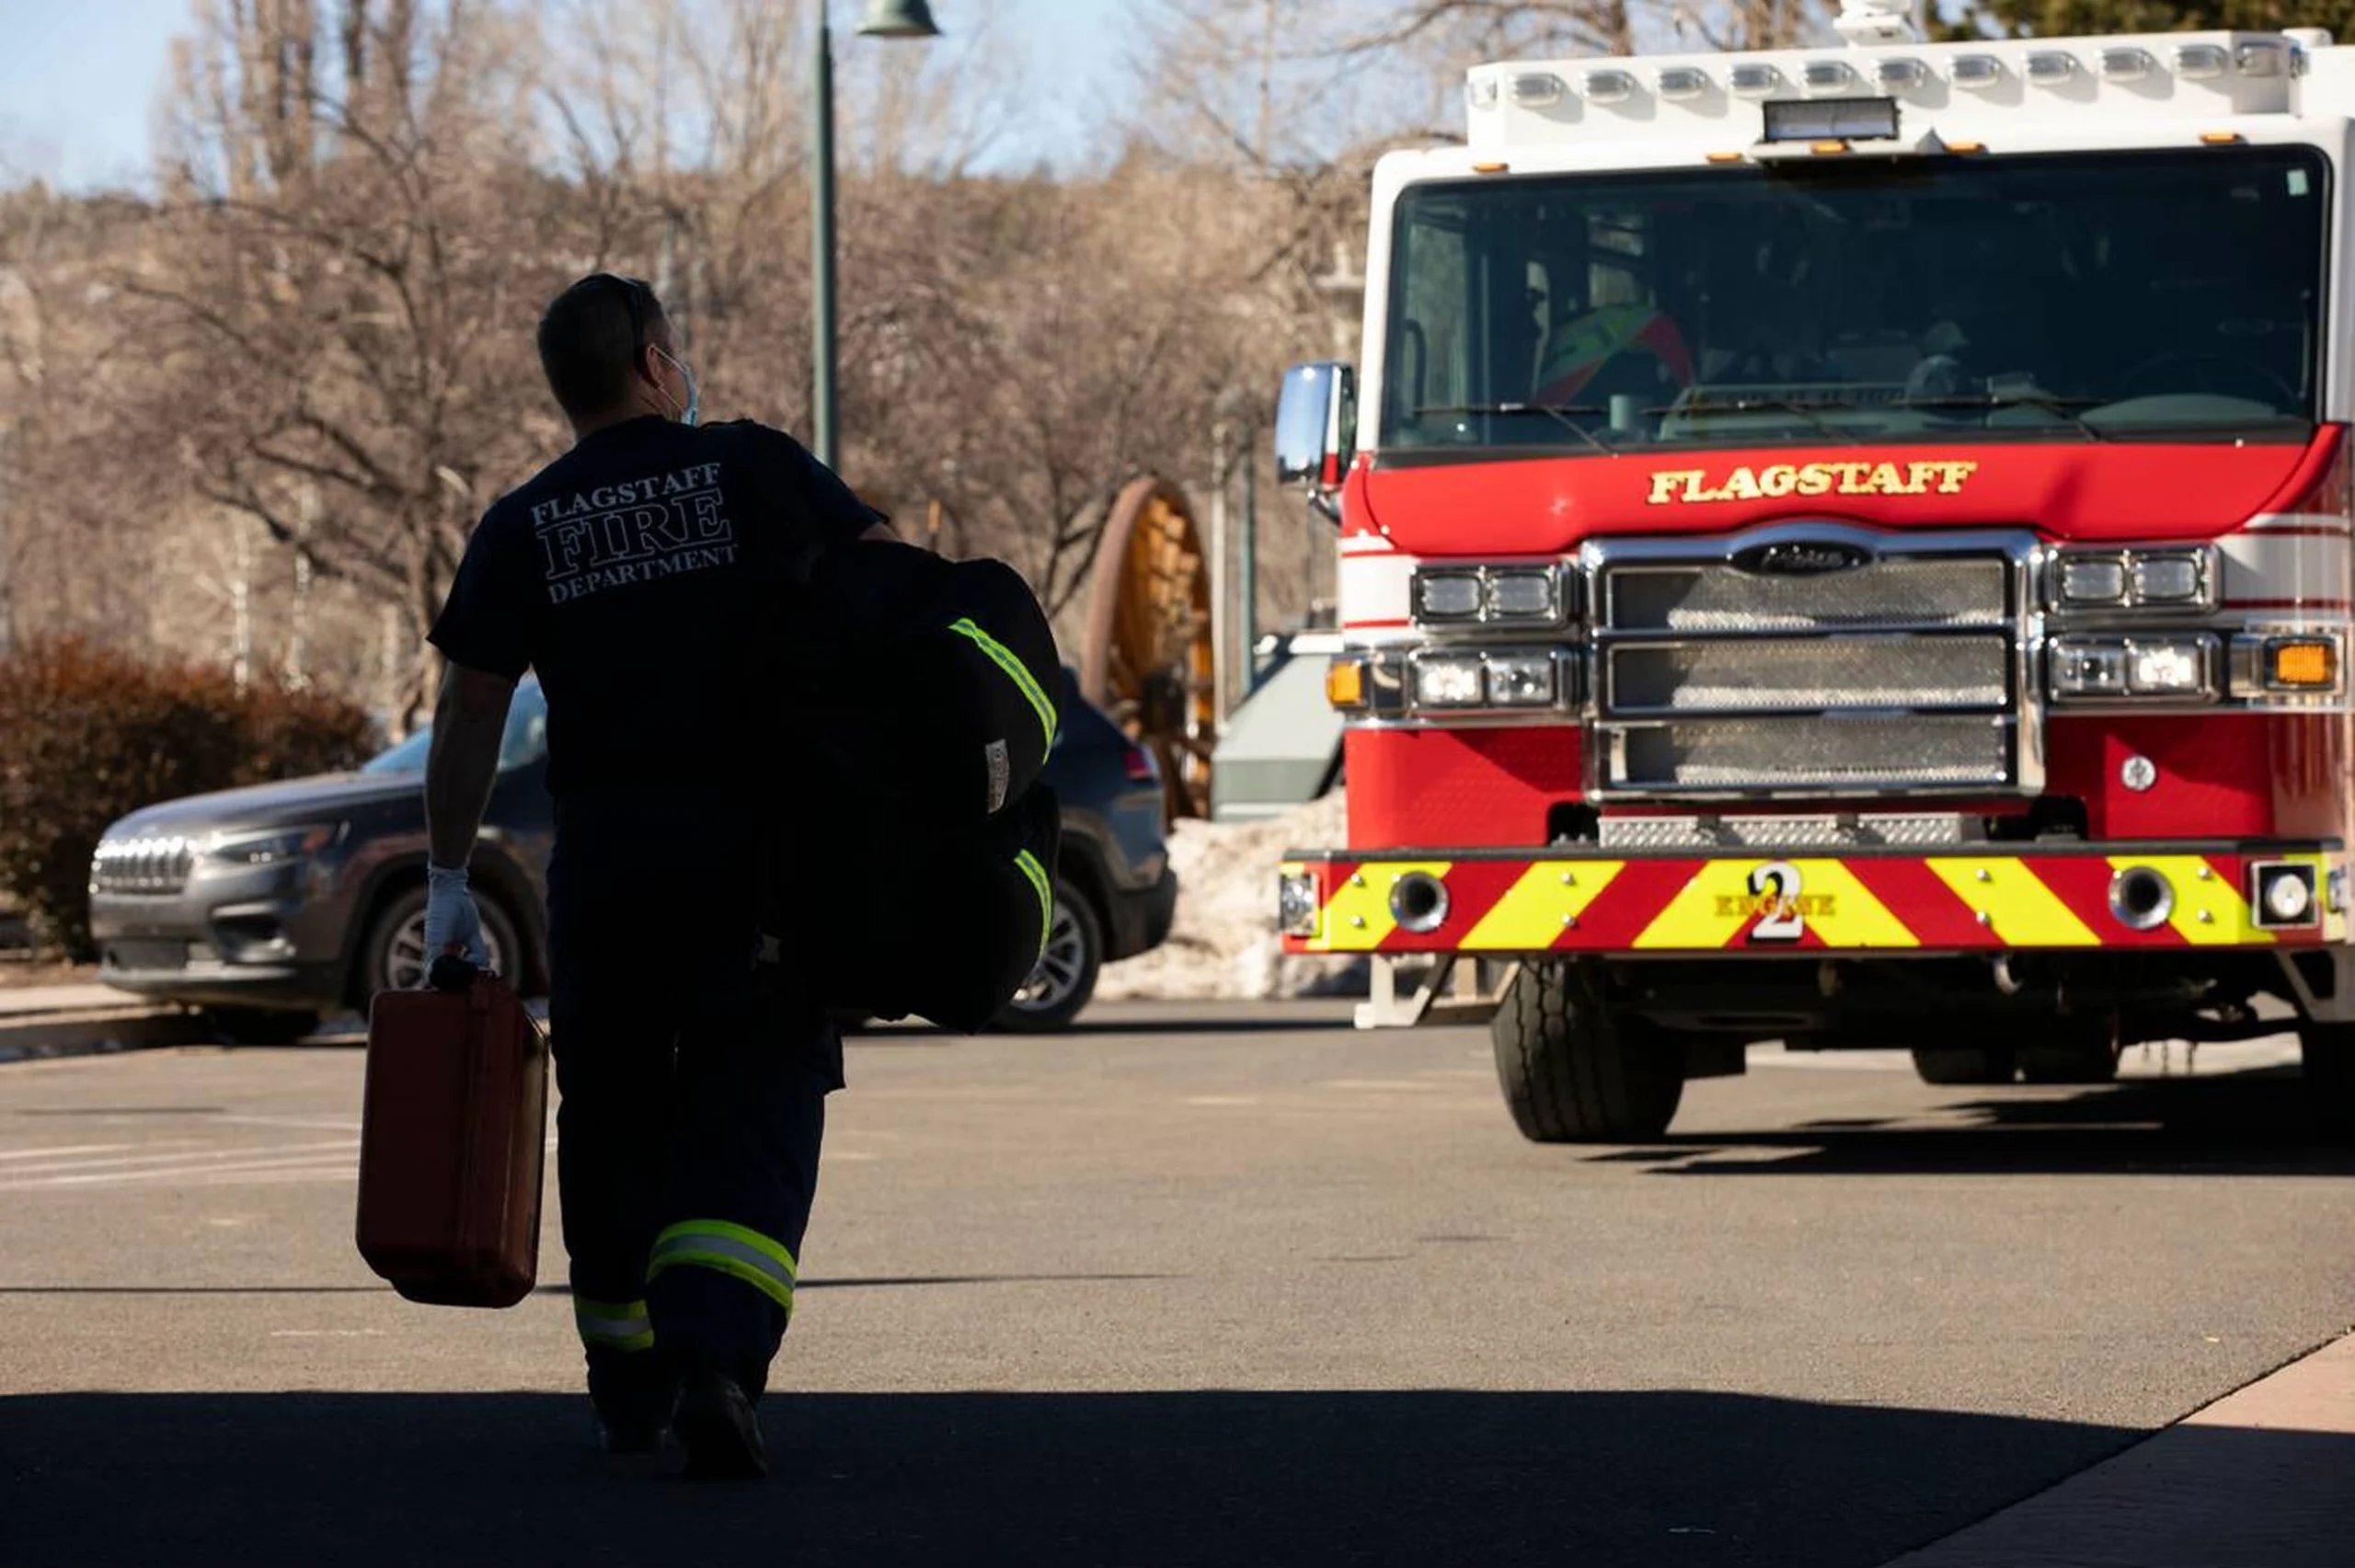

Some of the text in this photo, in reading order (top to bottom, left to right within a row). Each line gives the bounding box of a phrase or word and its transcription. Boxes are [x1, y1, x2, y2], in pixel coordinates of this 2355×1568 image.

[532, 463, 720, 526] FLAGSTAFF
[1647, 463, 1977, 504] FLAGSTAFF
[536, 487, 731, 579] FIRE
[548, 544, 739, 604] DEPARTMENT
[1748, 862, 1804, 942] 2
